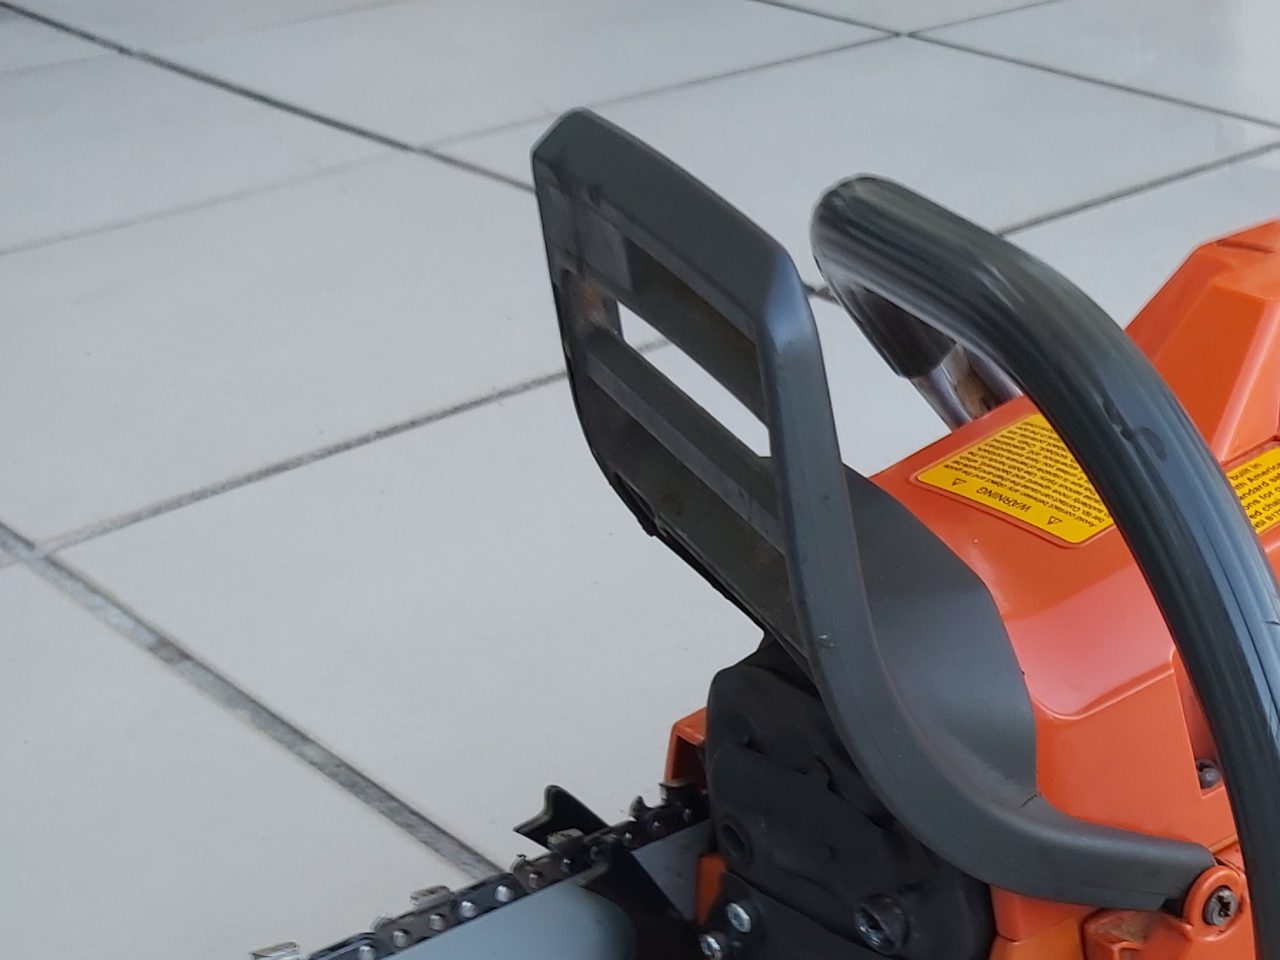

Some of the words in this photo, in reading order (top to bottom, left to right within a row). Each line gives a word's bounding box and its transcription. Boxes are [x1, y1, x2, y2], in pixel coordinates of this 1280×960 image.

[976, 487, 1031, 512] WARNING
[1052, 497, 1081, 512] Contact
[1048, 504, 1076, 517] contact
